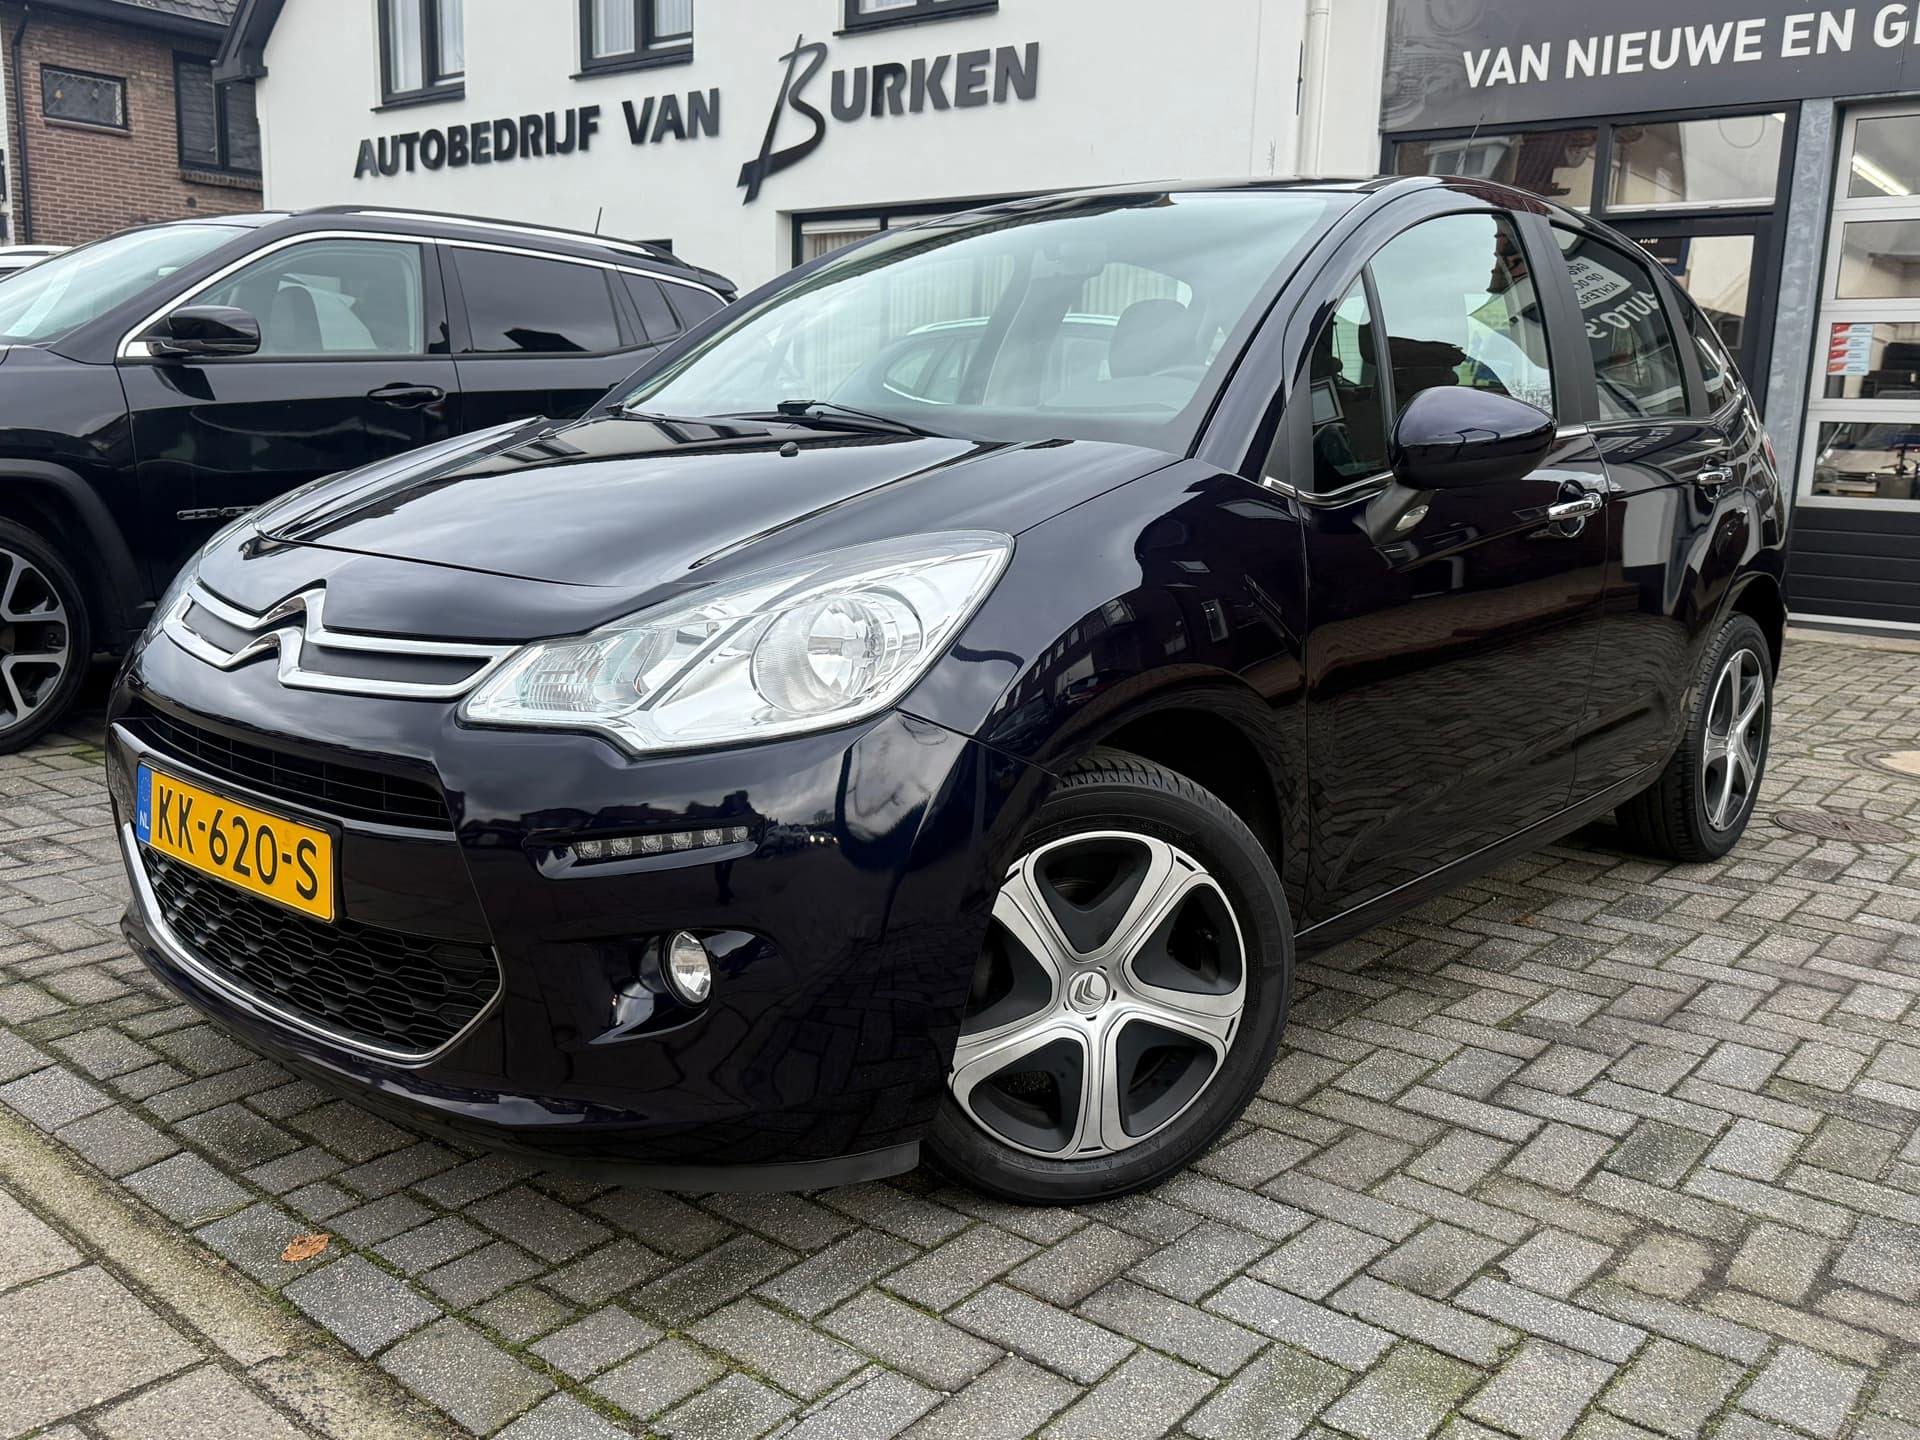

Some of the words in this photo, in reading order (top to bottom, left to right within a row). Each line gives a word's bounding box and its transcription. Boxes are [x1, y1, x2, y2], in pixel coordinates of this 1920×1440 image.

[1463, 42, 1551, 89] VAN
[1565, 18, 1767, 80] NIEUWE
[1781, 8, 1856, 58] EN
[1873, 3, 1920, 48] G
[354, 105, 601, 179] AUTOBEDRIJF
[621, 87, 720, 146] VAN
[737, 33, 1040, 206] BURKEN
[139, 809, 150, 830] NL
[158, 784, 318, 901] KK-620-S
